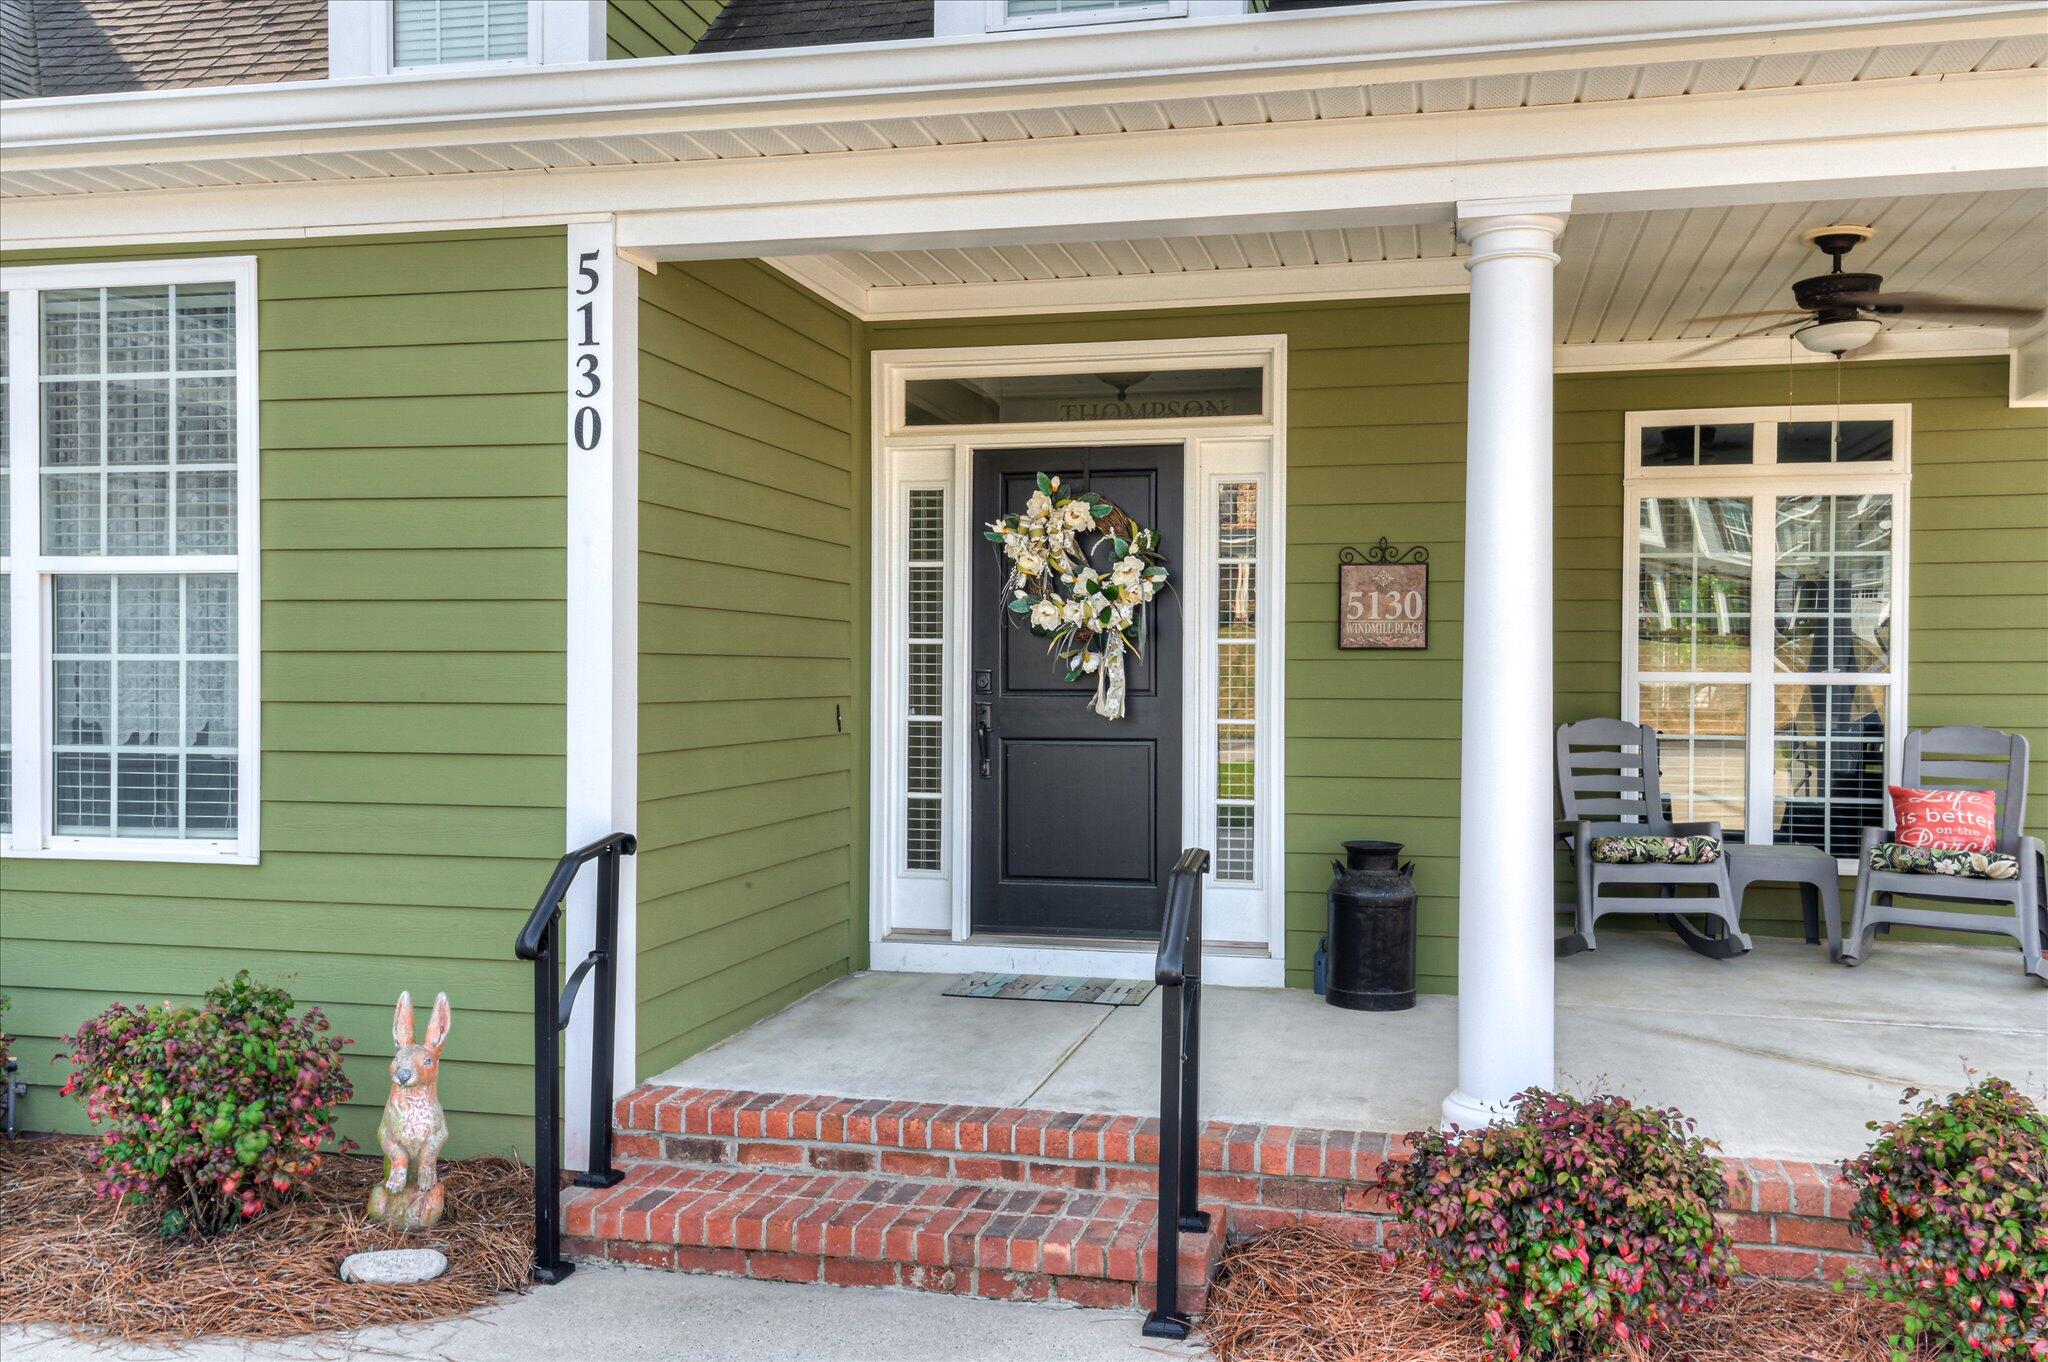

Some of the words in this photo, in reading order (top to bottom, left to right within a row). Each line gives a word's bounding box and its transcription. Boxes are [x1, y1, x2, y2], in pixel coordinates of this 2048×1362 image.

[574, 249, 602, 451] 5130
[1060, 400, 1229, 420] THOMPSON
[1346, 590, 1423, 620] 5130
[1345, 622, 1393, 634] WINDMILL
[1395, 622, 1424, 634] PLACE
[1909, 788, 1983, 811] Life
[1901, 811, 1917, 826] is
[1926, 807, 1992, 832] better
[1936, 827, 1953, 835] on
[1958, 827, 1981, 837] the
